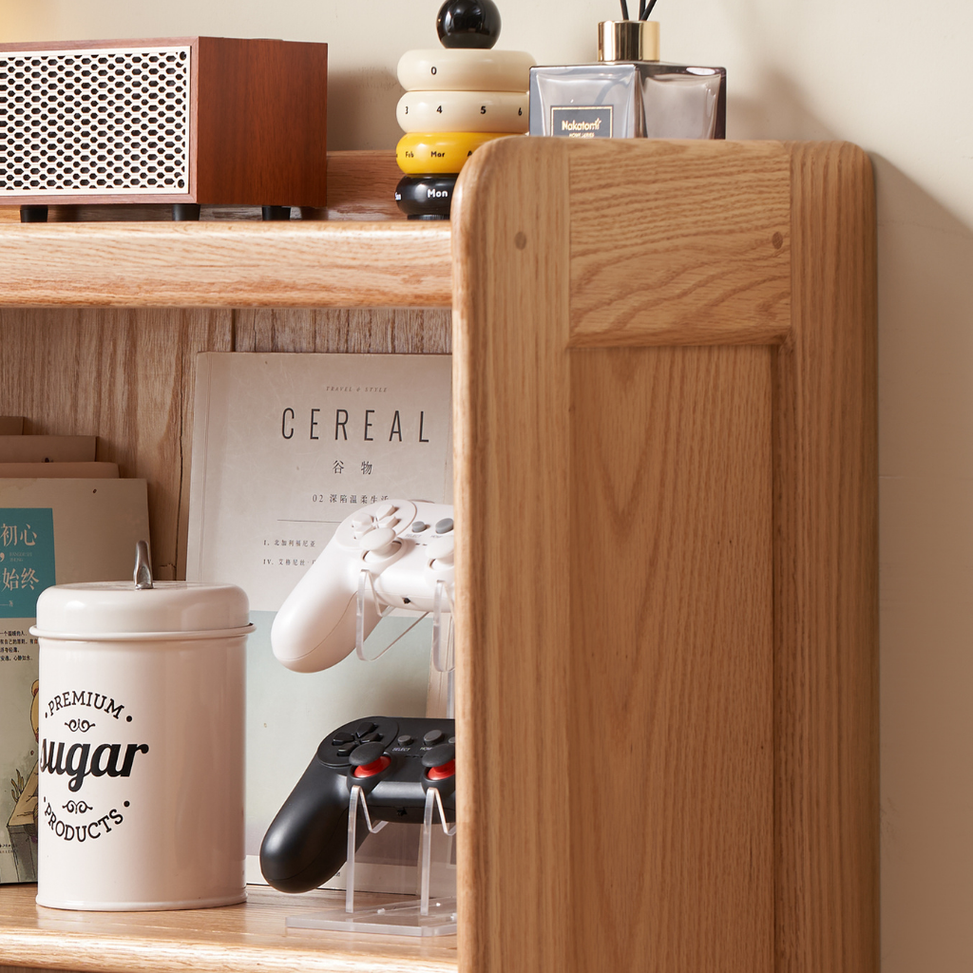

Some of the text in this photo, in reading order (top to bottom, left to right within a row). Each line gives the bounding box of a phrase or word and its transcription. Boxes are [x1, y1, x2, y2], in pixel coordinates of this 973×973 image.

[430, 66, 437, 75] 0
[436, 105, 443, 114] 4
[480, 106, 487, 115] 5
[518, 107, 523, 116] 6
[561, 118, 602, 131] Nakatomi
[427, 188, 448, 198] Mon
[281, 407, 430, 443] CEREAL
[312, 494, 324, 503] 02
[48, 690, 125, 719] PREMIUM
[44, 802, 124, 843] PRODUCTS
